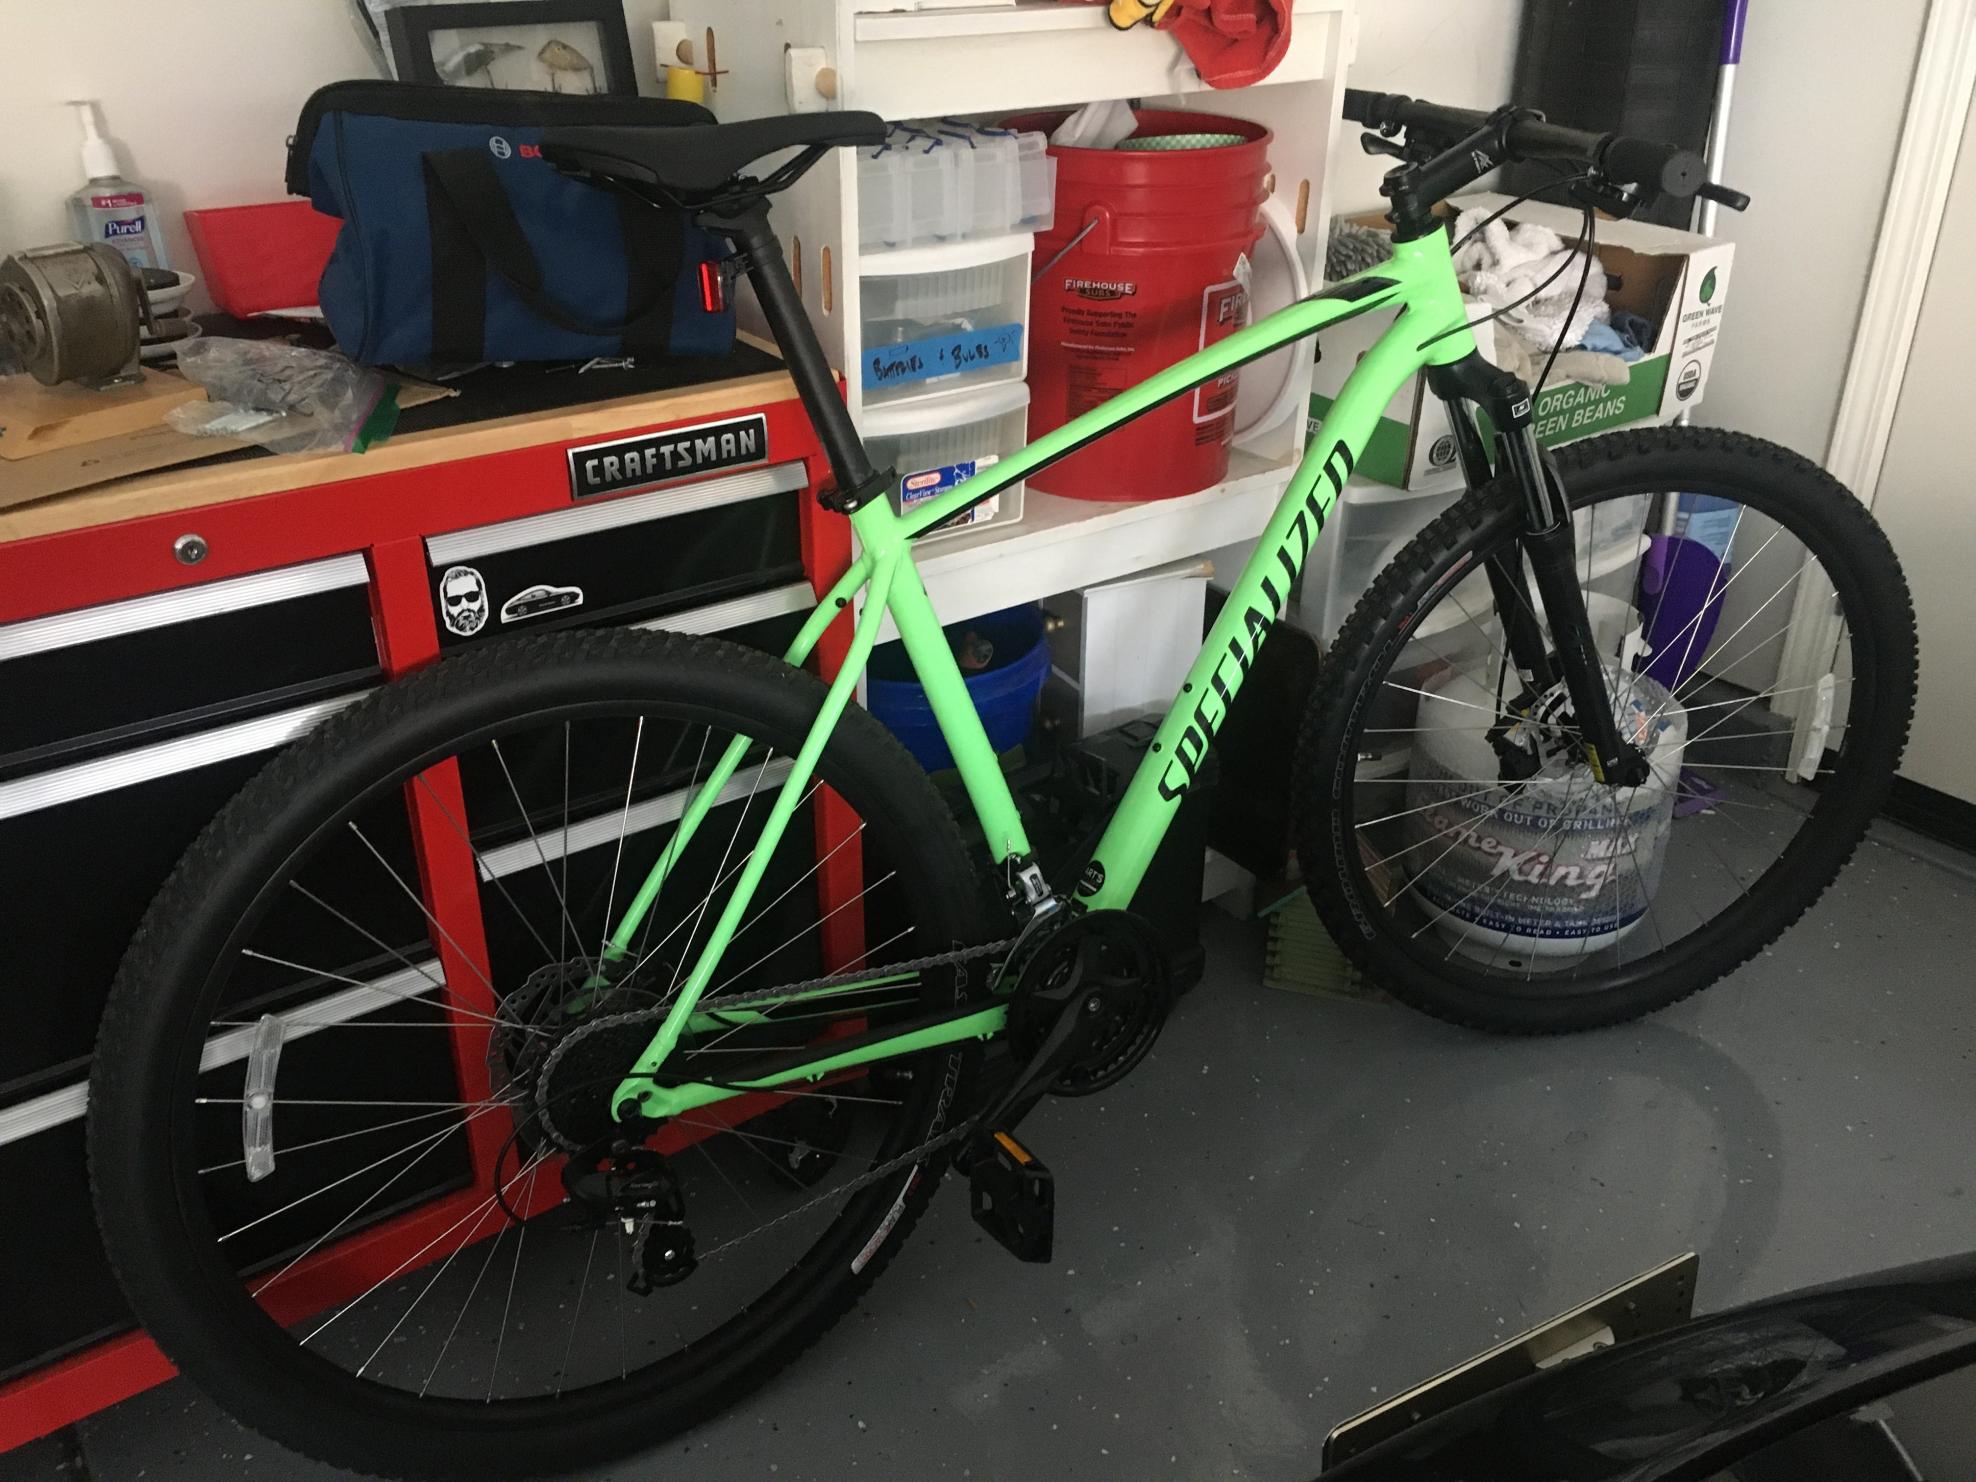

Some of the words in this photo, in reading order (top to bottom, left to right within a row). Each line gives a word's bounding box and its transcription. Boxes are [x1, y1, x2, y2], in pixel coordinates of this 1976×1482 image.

[108, 219, 142, 235] Purell
[1064, 278, 1134, 295] FIREHOUSE
[1682, 310, 1704, 323] GREEN
[1705, 304, 1723, 317] WAVE
[1538, 384, 1611, 416] ORGANIC
[1534, 413, 1570, 439] EEN
[1571, 396, 1627, 428] BEANS
[585, 428, 757, 486] CRAFTSMAN
[1157, 438, 1354, 802] SPECIALIZED
[1503, 811, 1533, 826] OUT
[1489, 843, 1617, 899] King
[1526, 926, 1552, 936] READ
[1564, 927, 1587, 936] EASY
